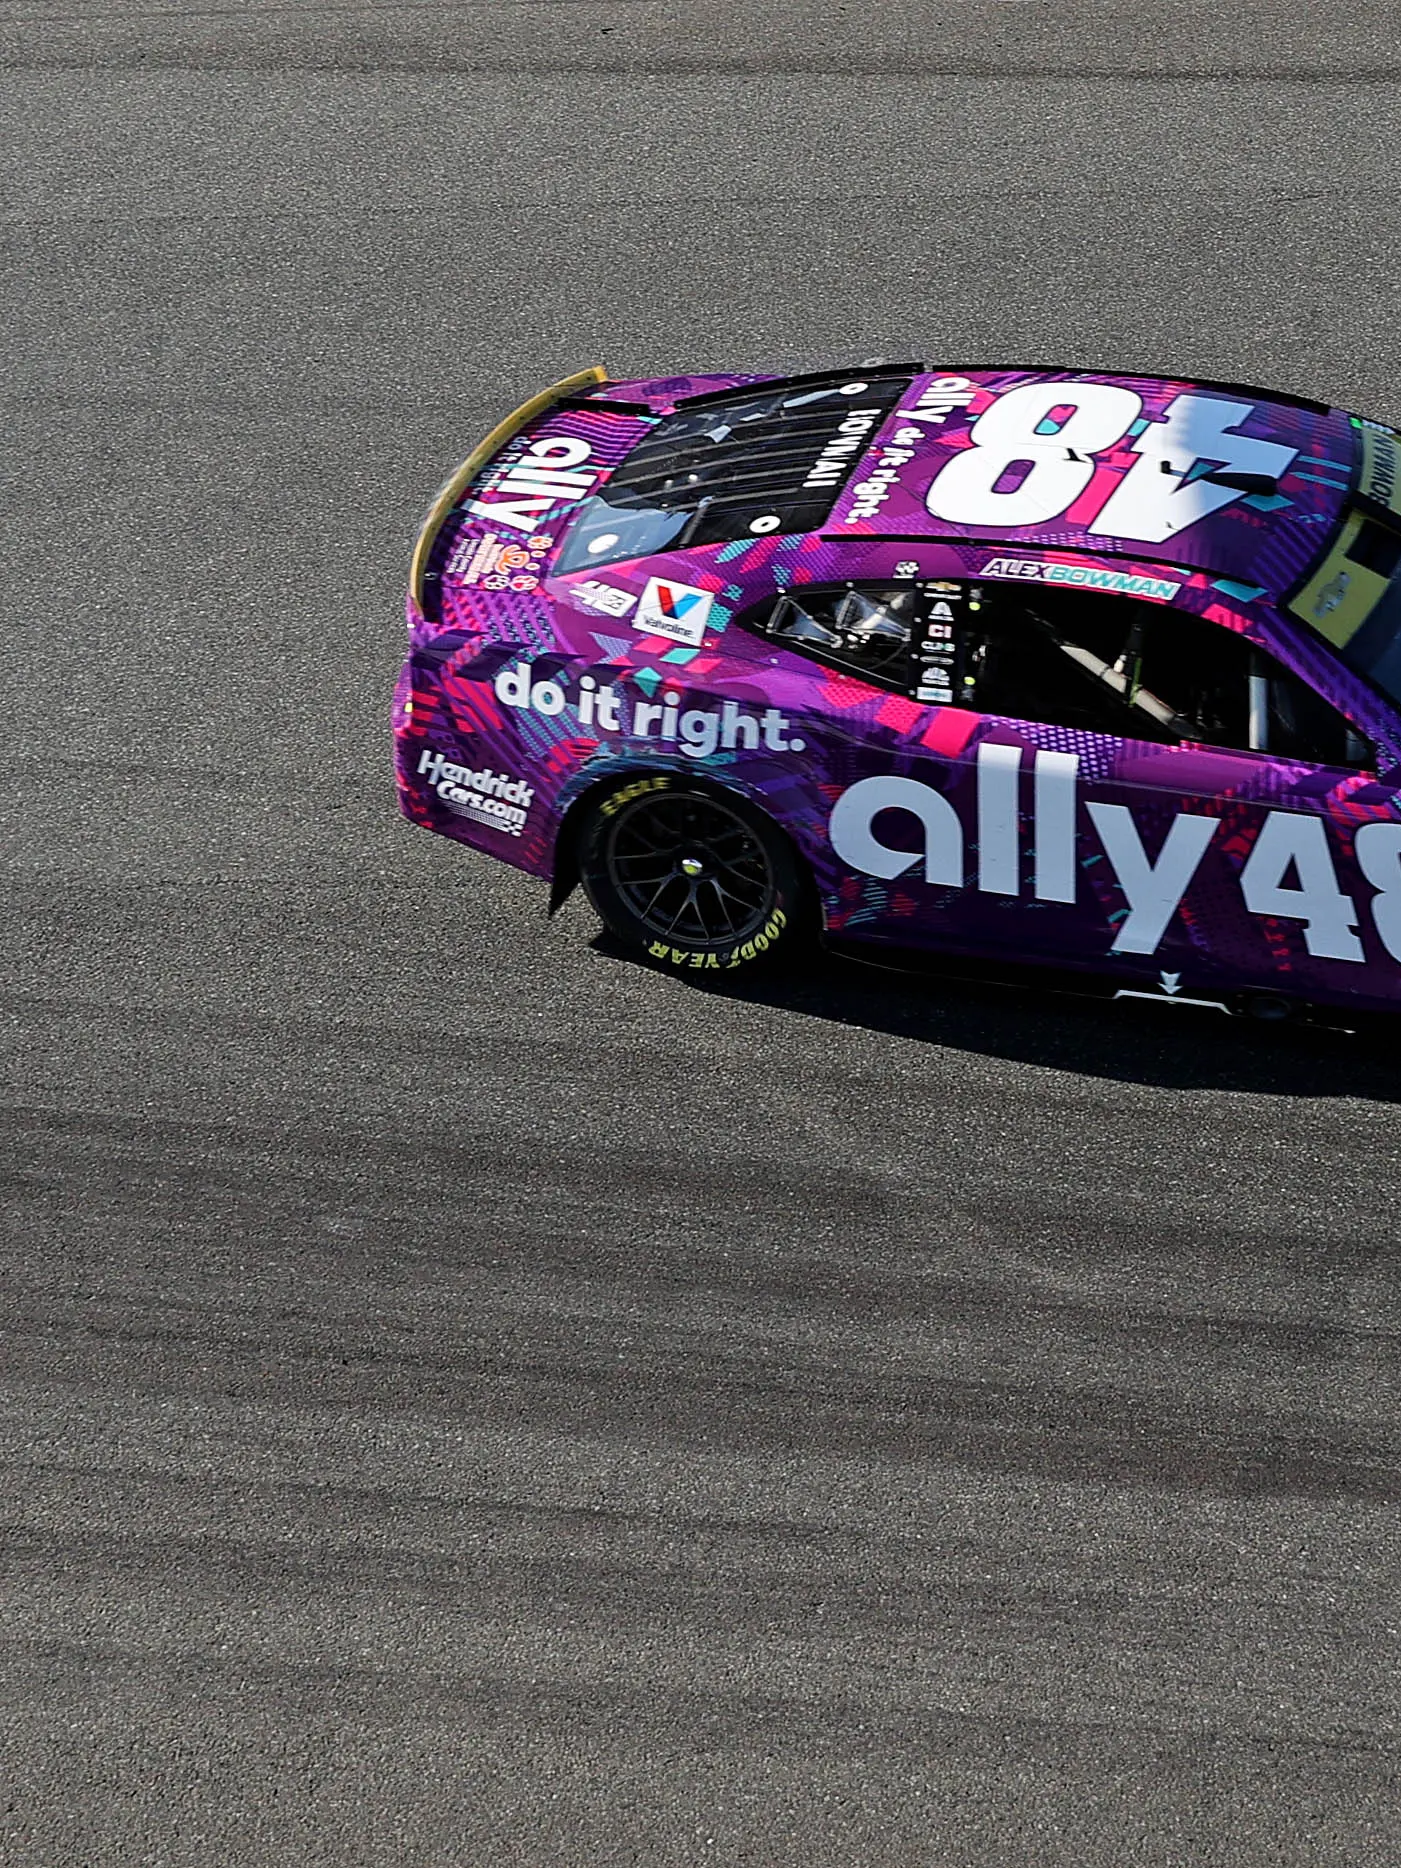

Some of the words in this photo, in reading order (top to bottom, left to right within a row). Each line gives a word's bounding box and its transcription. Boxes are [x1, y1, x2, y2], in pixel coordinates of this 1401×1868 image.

[895, 377, 977, 424] ally
[891, 426, 926, 446] do
[925, 381, 1300, 543] 48
[460, 436, 598, 533] ally
[643, 615, 697, 639] Valvoline
[494, 661, 566, 716] do
[577, 675, 621, 732] it
[633, 690, 806, 758] right.
[416, 749, 536, 808] Hendrick
[436, 780, 528, 826] Cars.com
[598, 776, 673, 817] EAGLE
[828, 742, 1221, 956] ally
[647, 907, 788, 970] GOODYEAR
